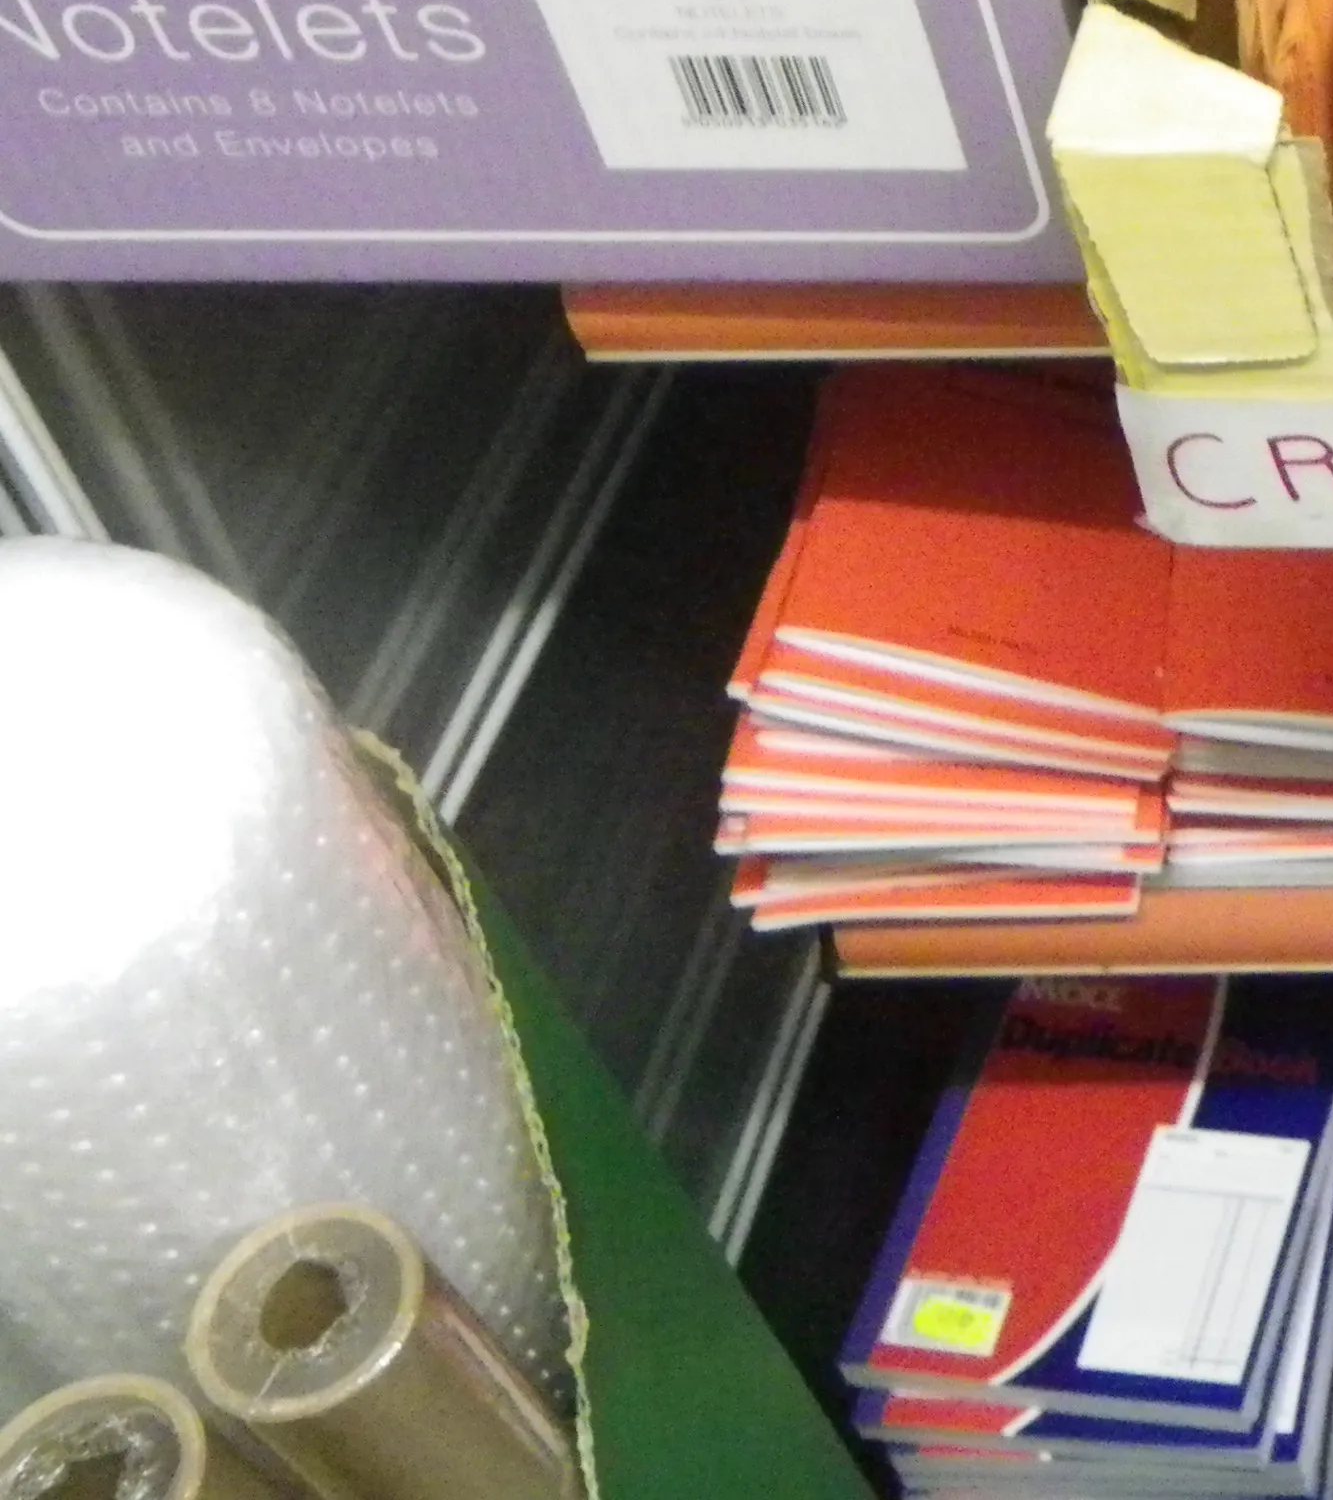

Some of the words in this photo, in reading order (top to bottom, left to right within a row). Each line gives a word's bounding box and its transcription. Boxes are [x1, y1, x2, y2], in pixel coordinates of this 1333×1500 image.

[38, 88, 234, 117] Contains
[248, 88, 278, 117] 8
[292, 88, 480, 117] Notelets
[121, 132, 200, 158] and
[214, 129, 440, 161] Envelopes
